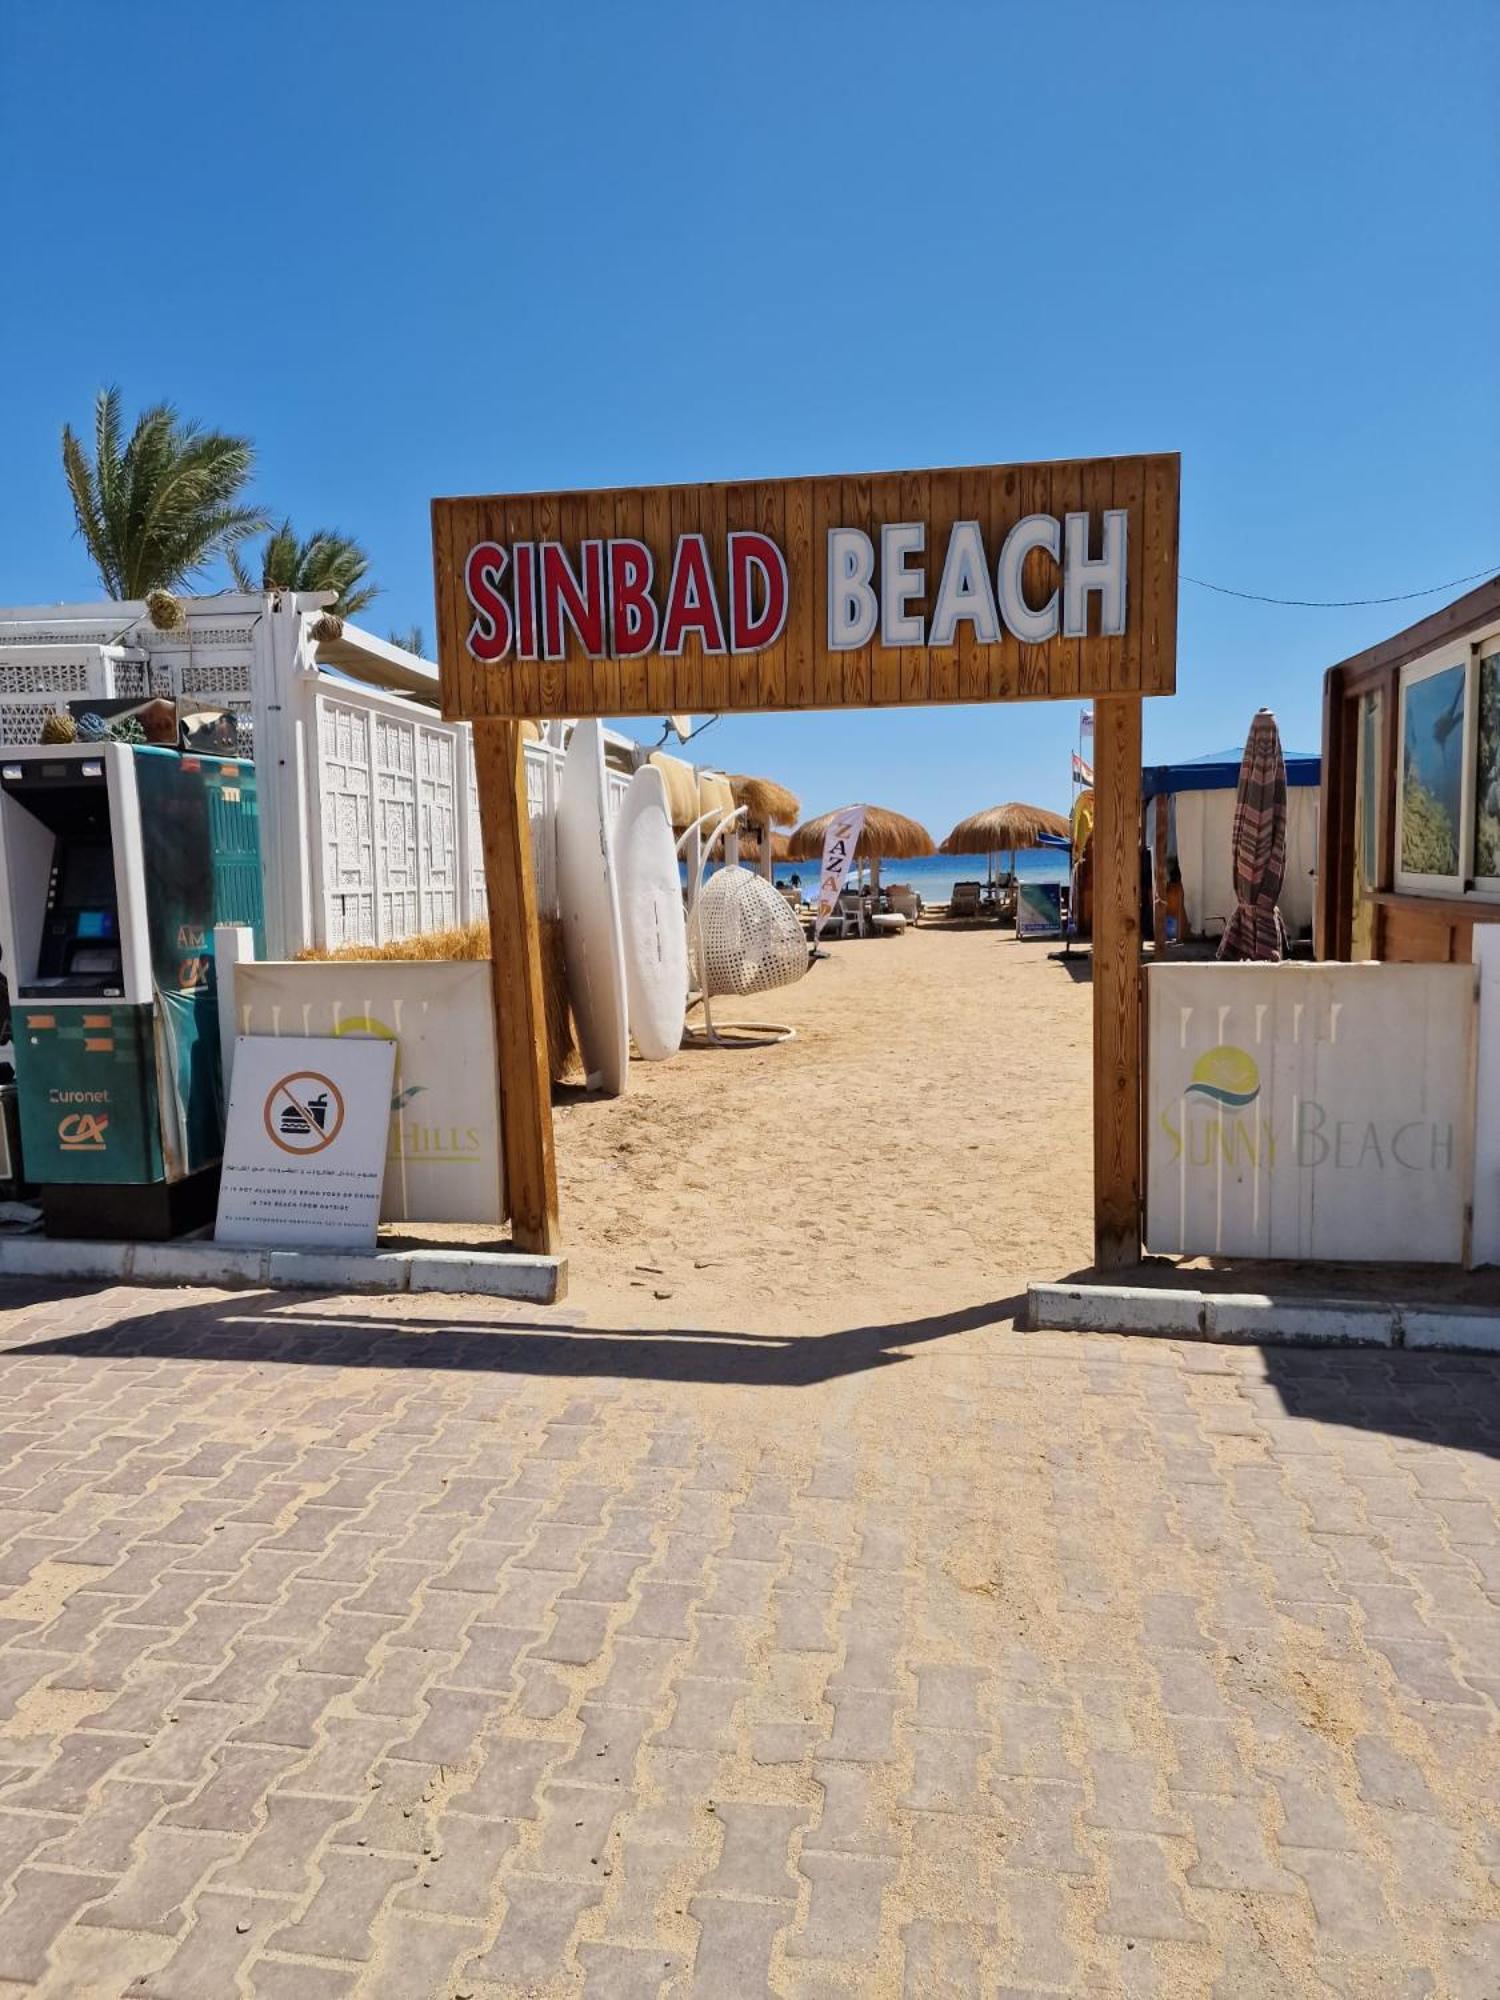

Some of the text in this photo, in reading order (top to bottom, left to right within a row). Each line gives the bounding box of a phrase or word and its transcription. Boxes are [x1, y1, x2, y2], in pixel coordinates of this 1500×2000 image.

[465, 509, 1128, 663] SINBAD BEACH
[49, 1088, 109, 1104] Euronet
[1160, 1099, 1453, 1172] SUNNY BEACH
